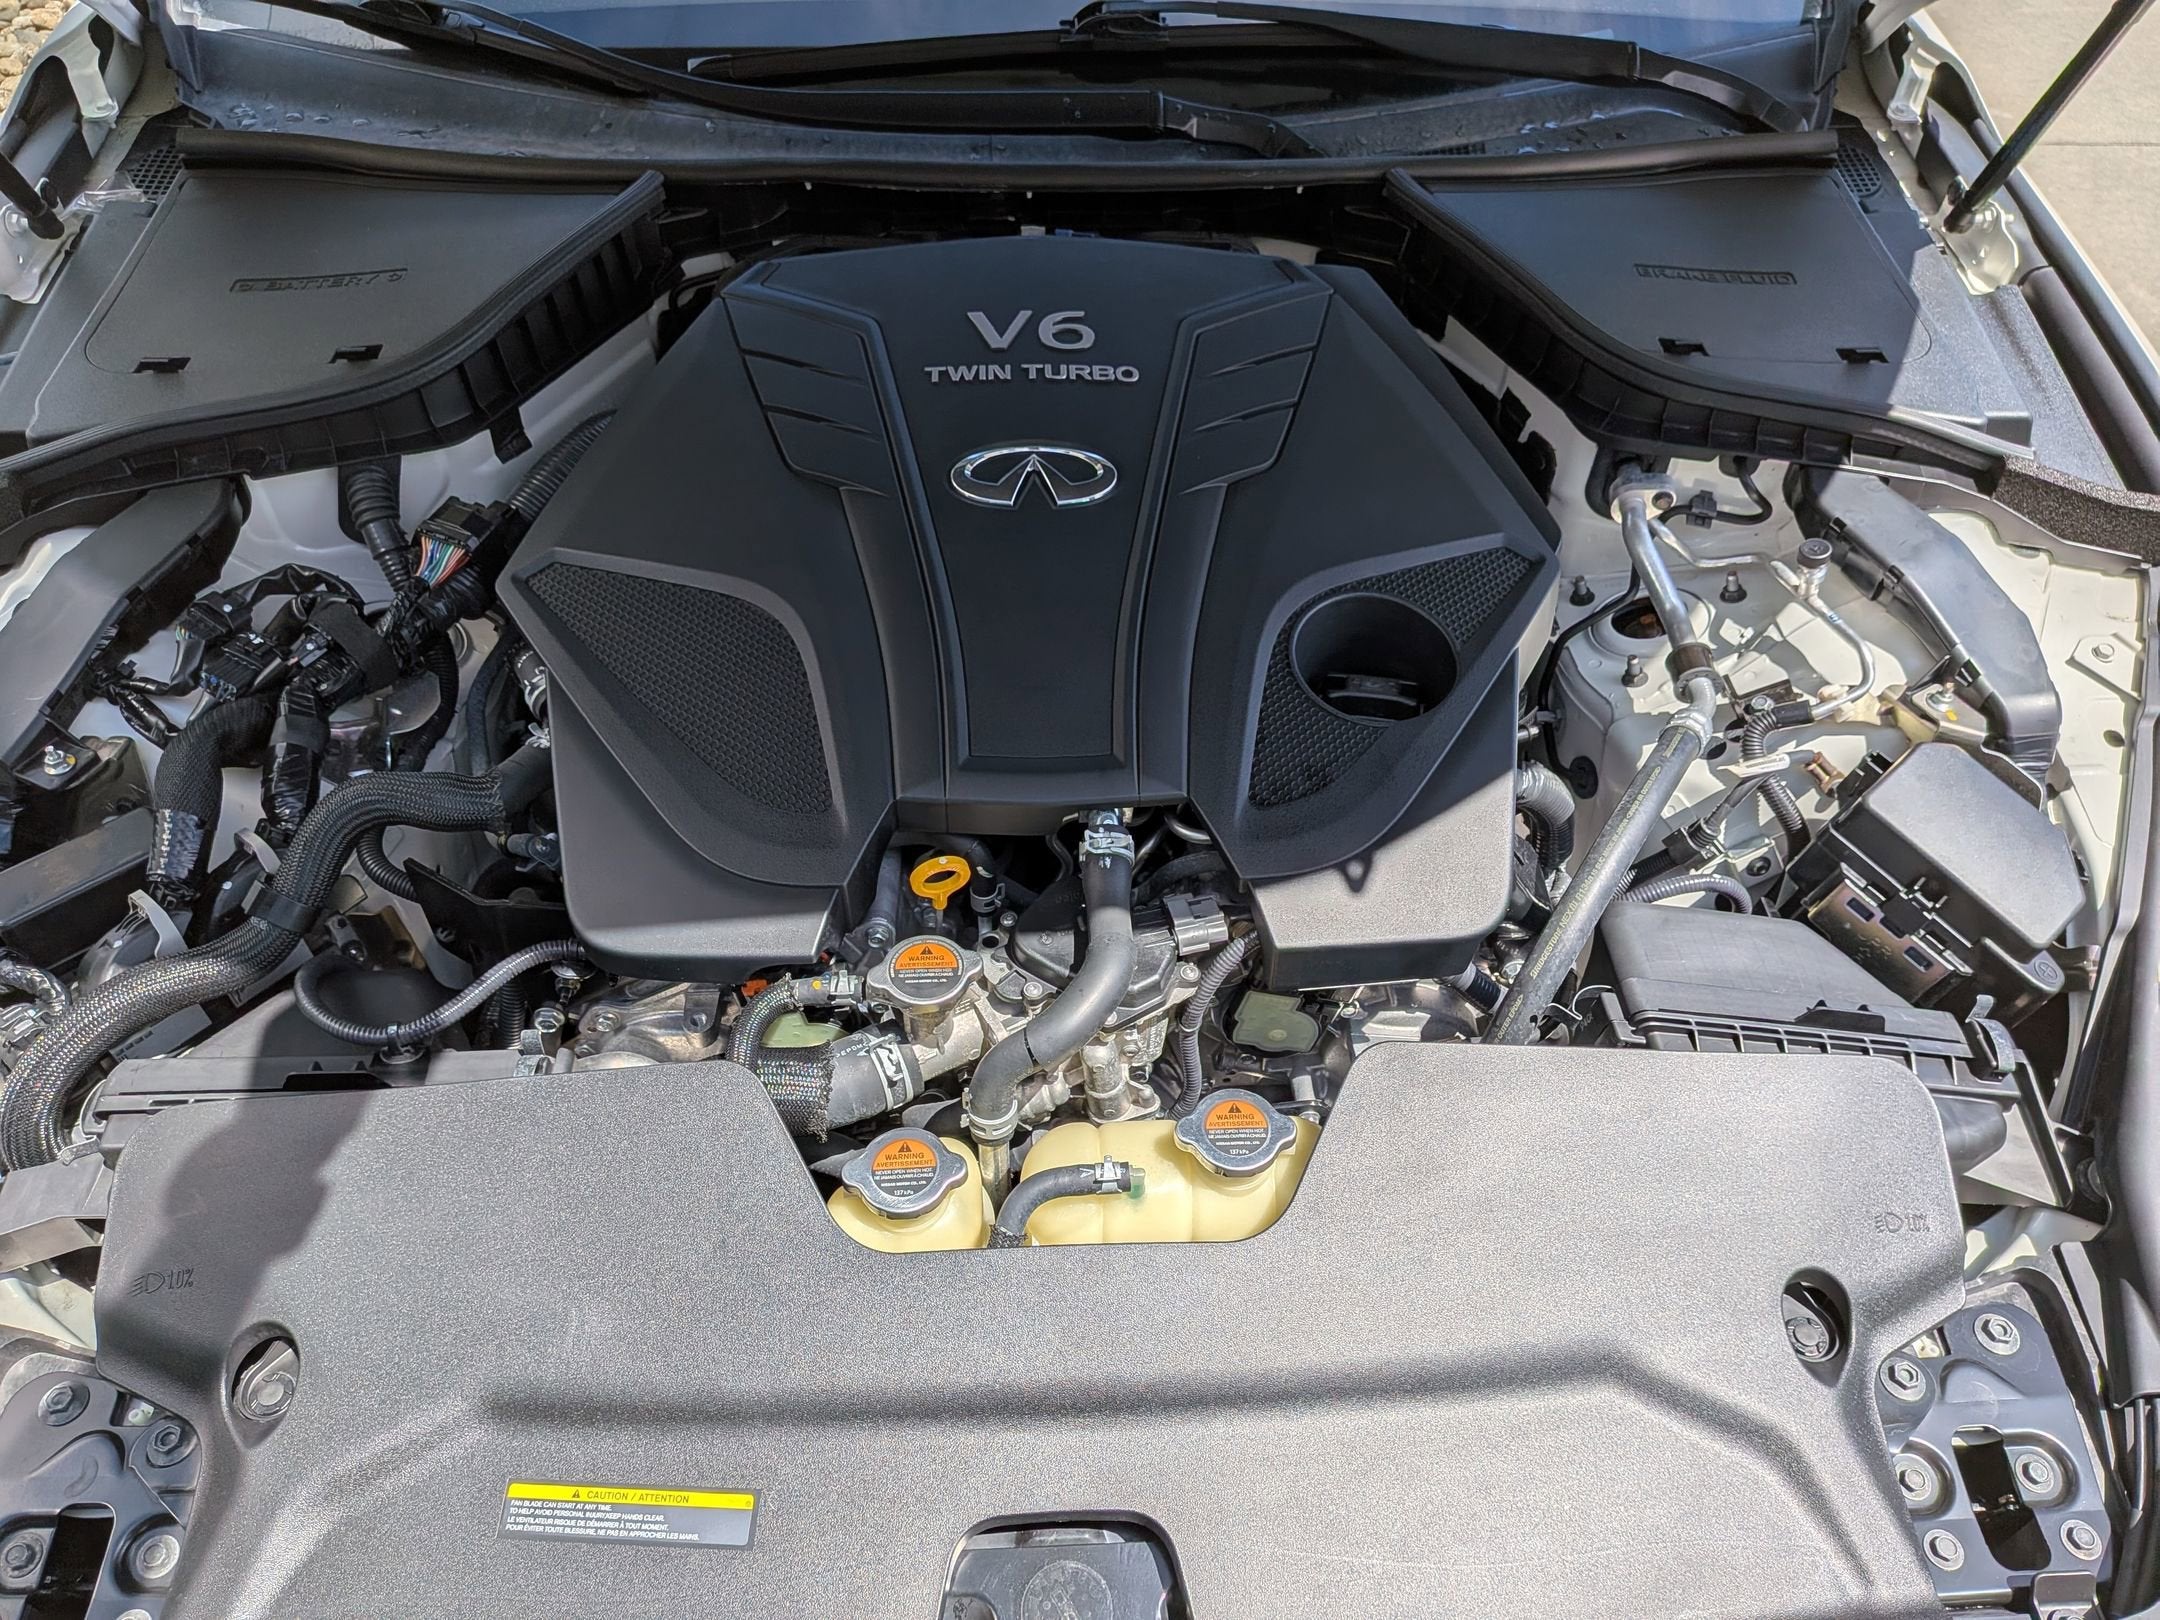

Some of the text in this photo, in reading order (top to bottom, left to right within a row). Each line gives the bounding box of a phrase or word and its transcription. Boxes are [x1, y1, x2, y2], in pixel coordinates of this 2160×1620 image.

[1724, 272, 1790, 284] FLUID
[966, 310, 1096, 350] V6
[924, 364, 1140, 382] TWIN TURBO
[885, 1152, 924, 1161] WARNING
[587, 1491, 628, 1500] CAUTION
[638, 1494, 689, 1504] ATTENTION
[516, 1516, 553, 1524] VENTILATEUR
[586, 1519, 619, 1528] DÉMARRER
[524, 1523, 544, 1532] ÉVITER
[629, 1530, 666, 1538] APPROCHER
